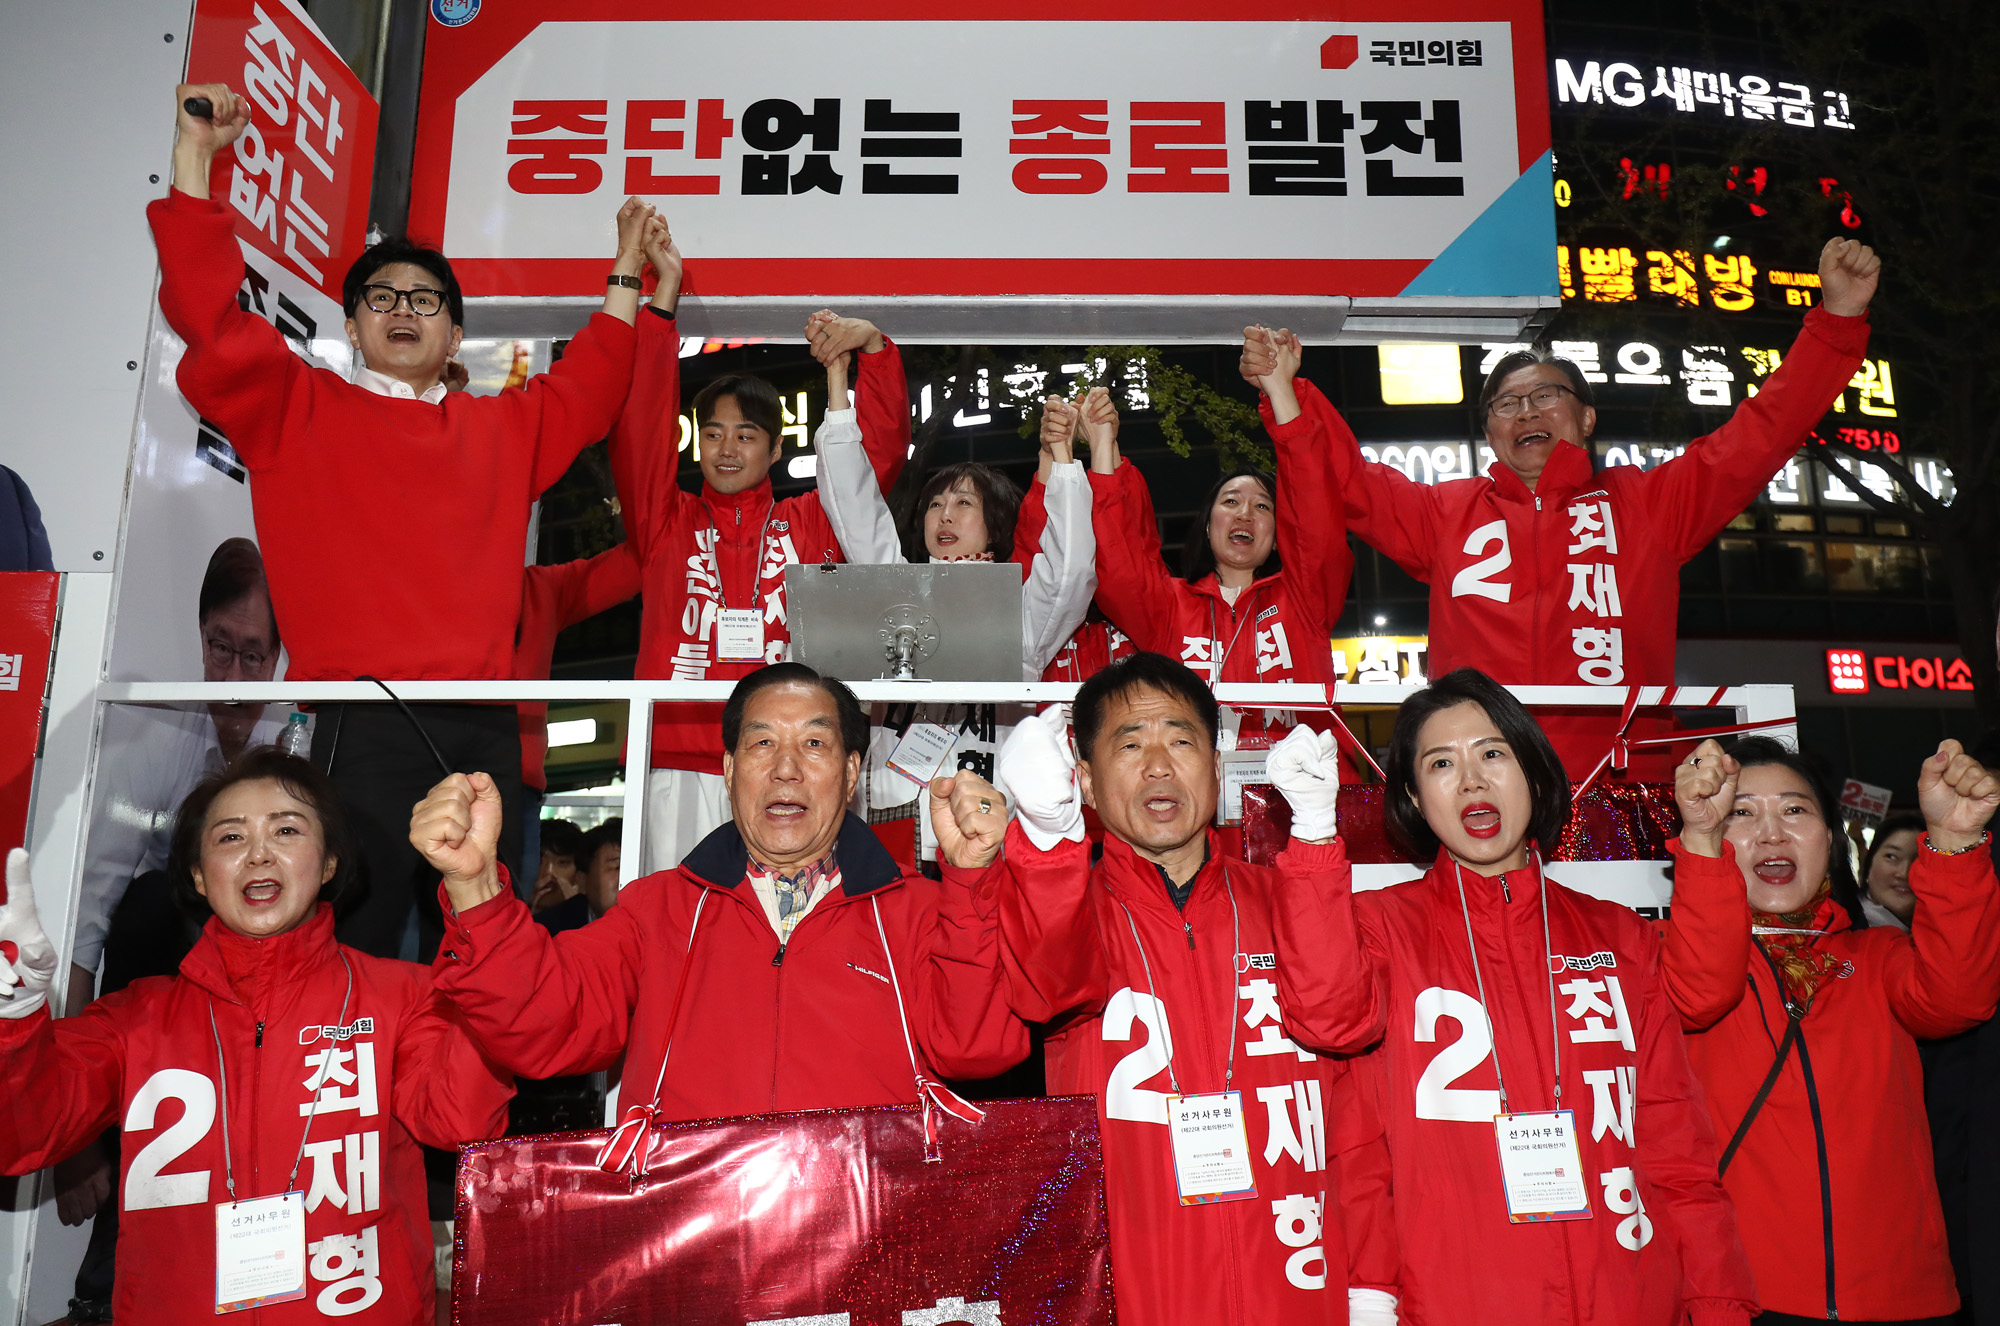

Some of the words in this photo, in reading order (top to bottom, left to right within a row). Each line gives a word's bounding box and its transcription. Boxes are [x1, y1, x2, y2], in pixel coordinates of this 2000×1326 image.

[243, 2, 343, 183] 중단
[1369, 40, 1483, 67] 국민의힘
[229, 123, 331, 287] 없는
[1786, 288, 1812, 306] B1
[1792, 272, 1822, 288] LAUNDR
[1452, 519, 1513, 603] 2
[1567, 500, 1625, 686] 최재형
[1873, 656, 1974, 690] 다이소
[1567, 952, 1616, 970] 국민의힘
[323, 1018, 373, 1040] 국민의힘
[1101, 986, 1173, 1125] 2
[1414, 986, 1501, 1122] 2
[124, 1068, 217, 1211] 2
[1181, 1108, 1232, 1121] 선거사무원
[1239, 979, 1327, 1290] 최재형
[1509, 1127, 1564, 1139] 선거사무원
[1558, 975, 1654, 1251] 최재형
[299, 1041, 383, 1317] 최재형
